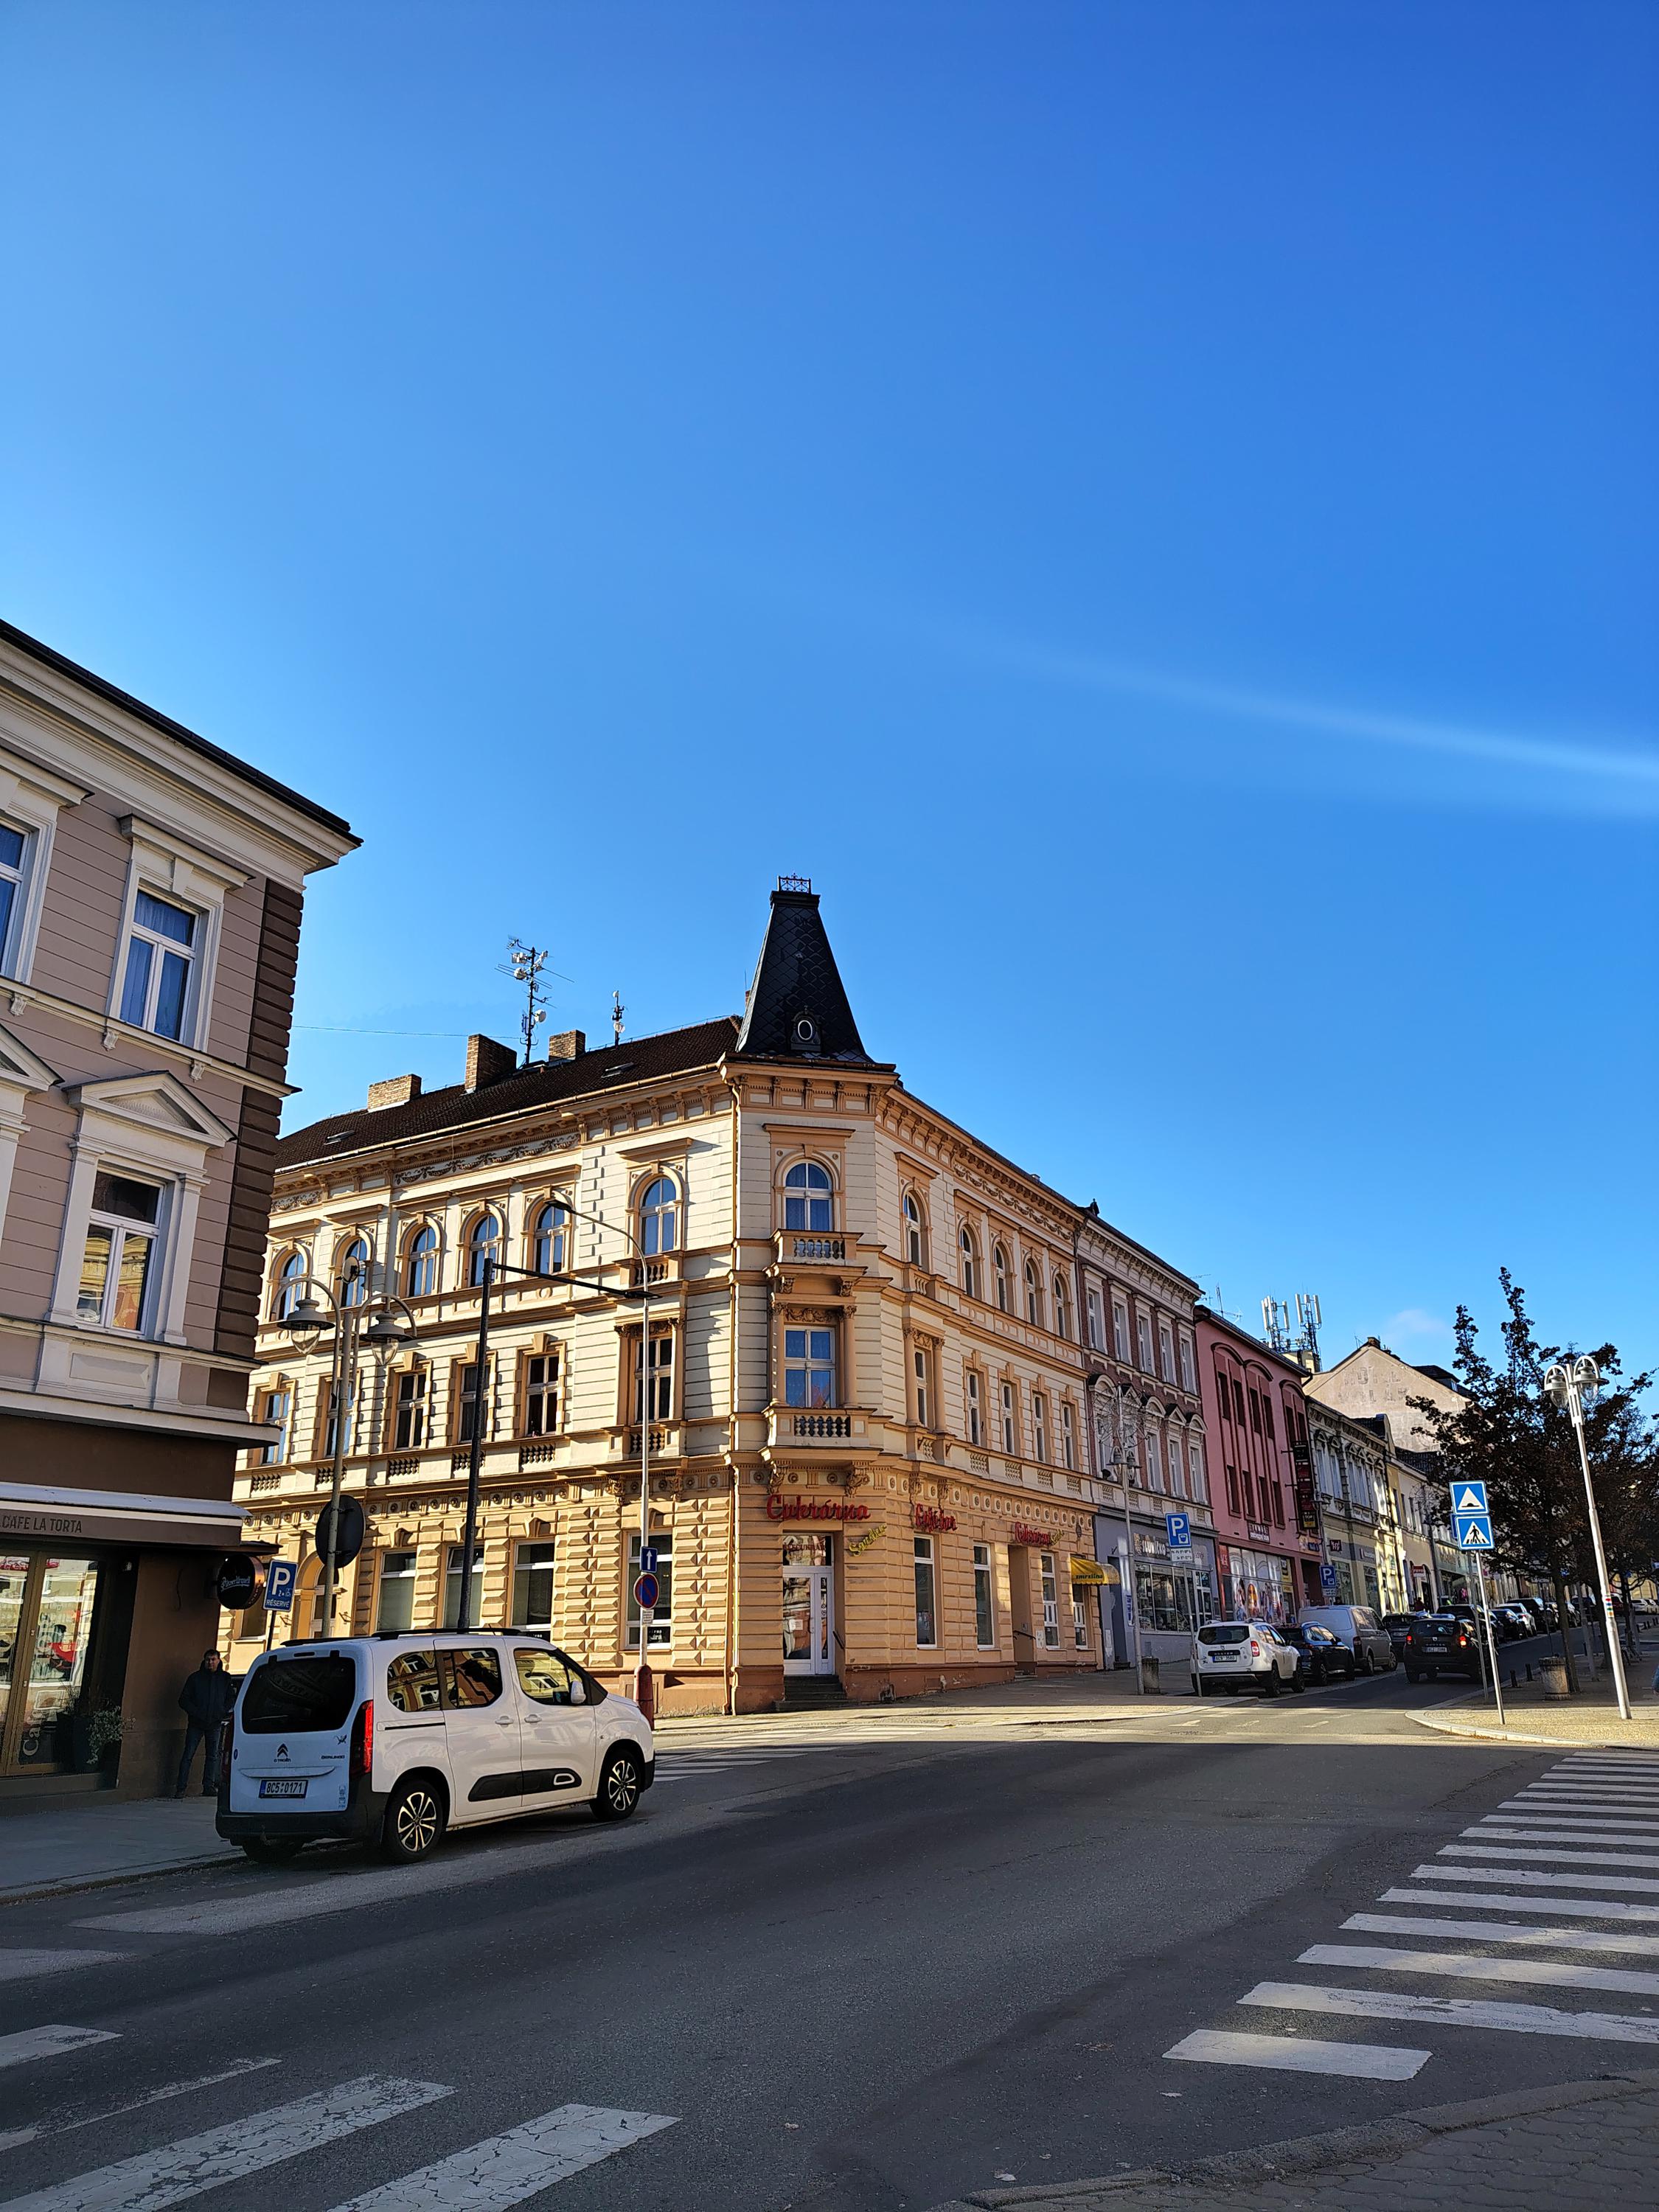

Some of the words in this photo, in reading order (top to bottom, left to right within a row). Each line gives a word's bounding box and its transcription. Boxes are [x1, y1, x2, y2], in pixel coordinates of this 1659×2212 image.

[767, 1494, 871, 1521] Cukrárna
[33, 1517, 46, 1531] LA
[50, 1518, 82, 1533] TORTA
[1171, 1517, 1184, 1537] P
[272, 1568, 291, 1595] P
